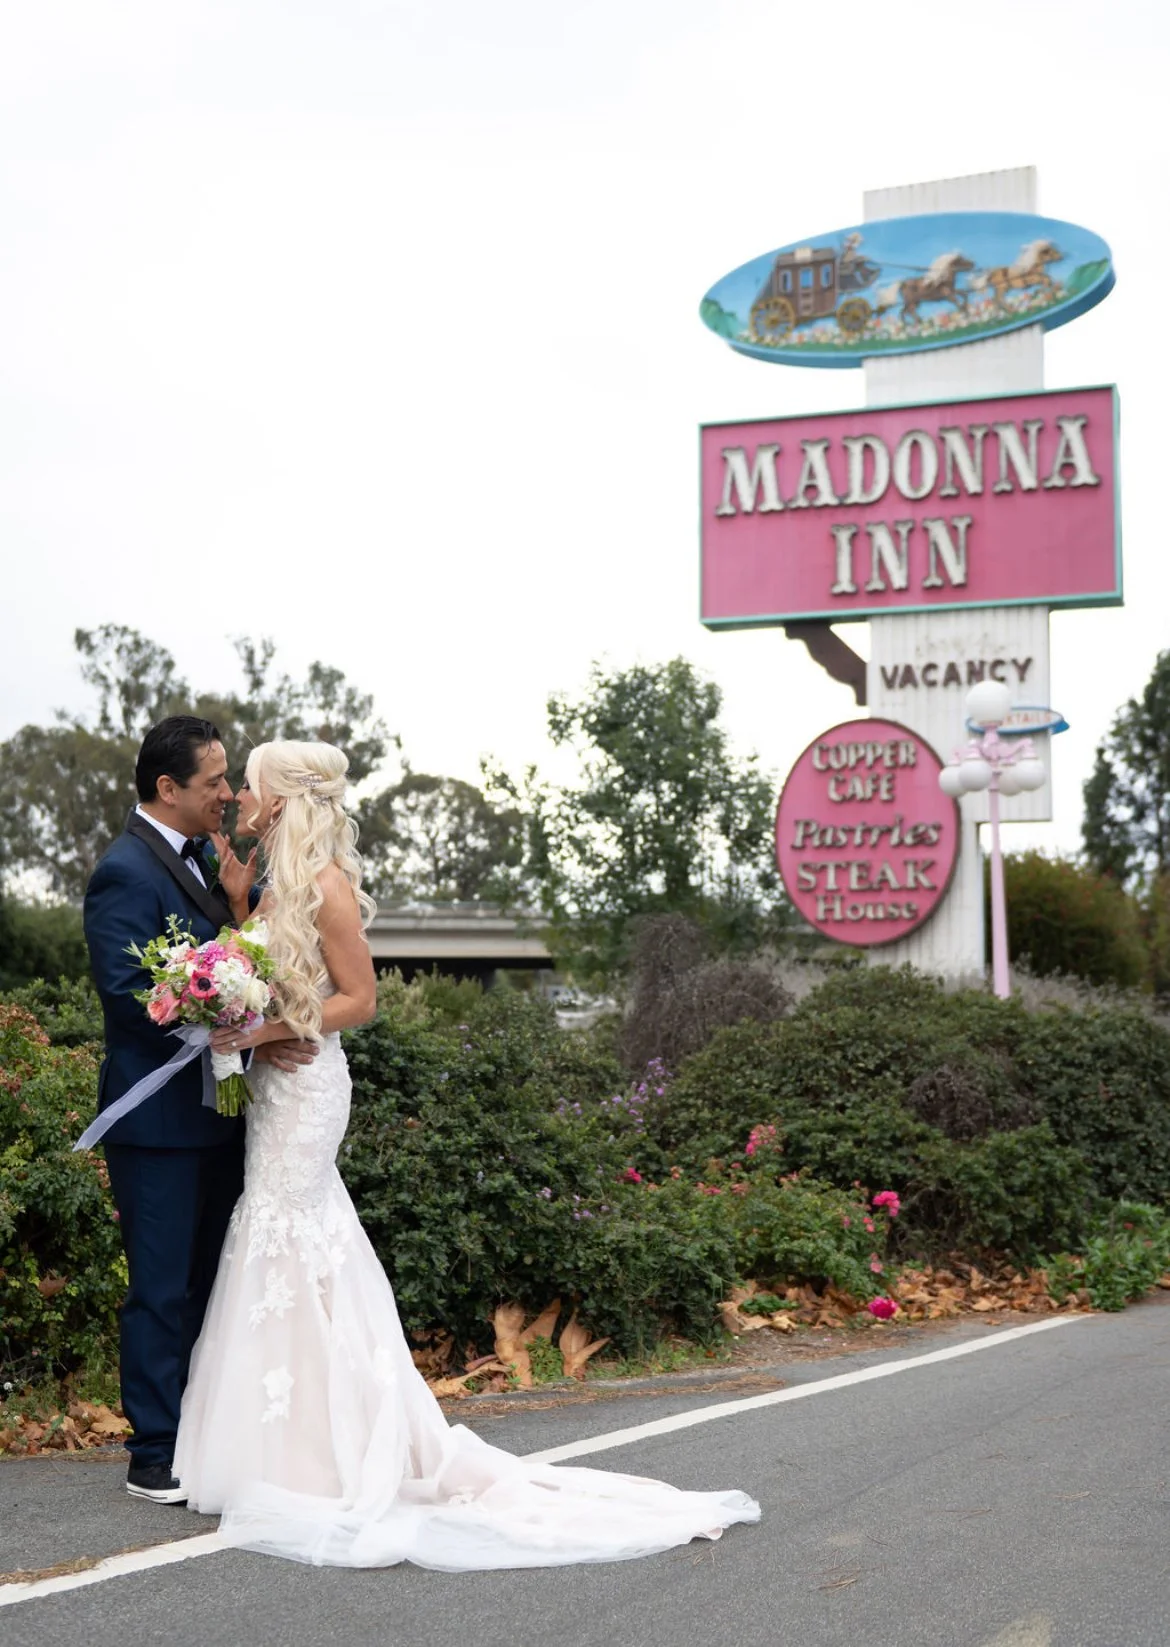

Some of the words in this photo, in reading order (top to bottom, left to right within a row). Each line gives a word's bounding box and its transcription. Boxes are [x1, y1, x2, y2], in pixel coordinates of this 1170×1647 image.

[715, 415, 1102, 517] MADONNA
[830, 515, 972, 596] INN
[880, 657, 1033, 690] VACANCY
[811, 739, 918, 772] COPPER
[827, 772, 896, 805] CAFE
[790, 815, 942, 851] Pastries
[796, 859, 939, 892] STEAK
[815, 894, 919, 922] House
